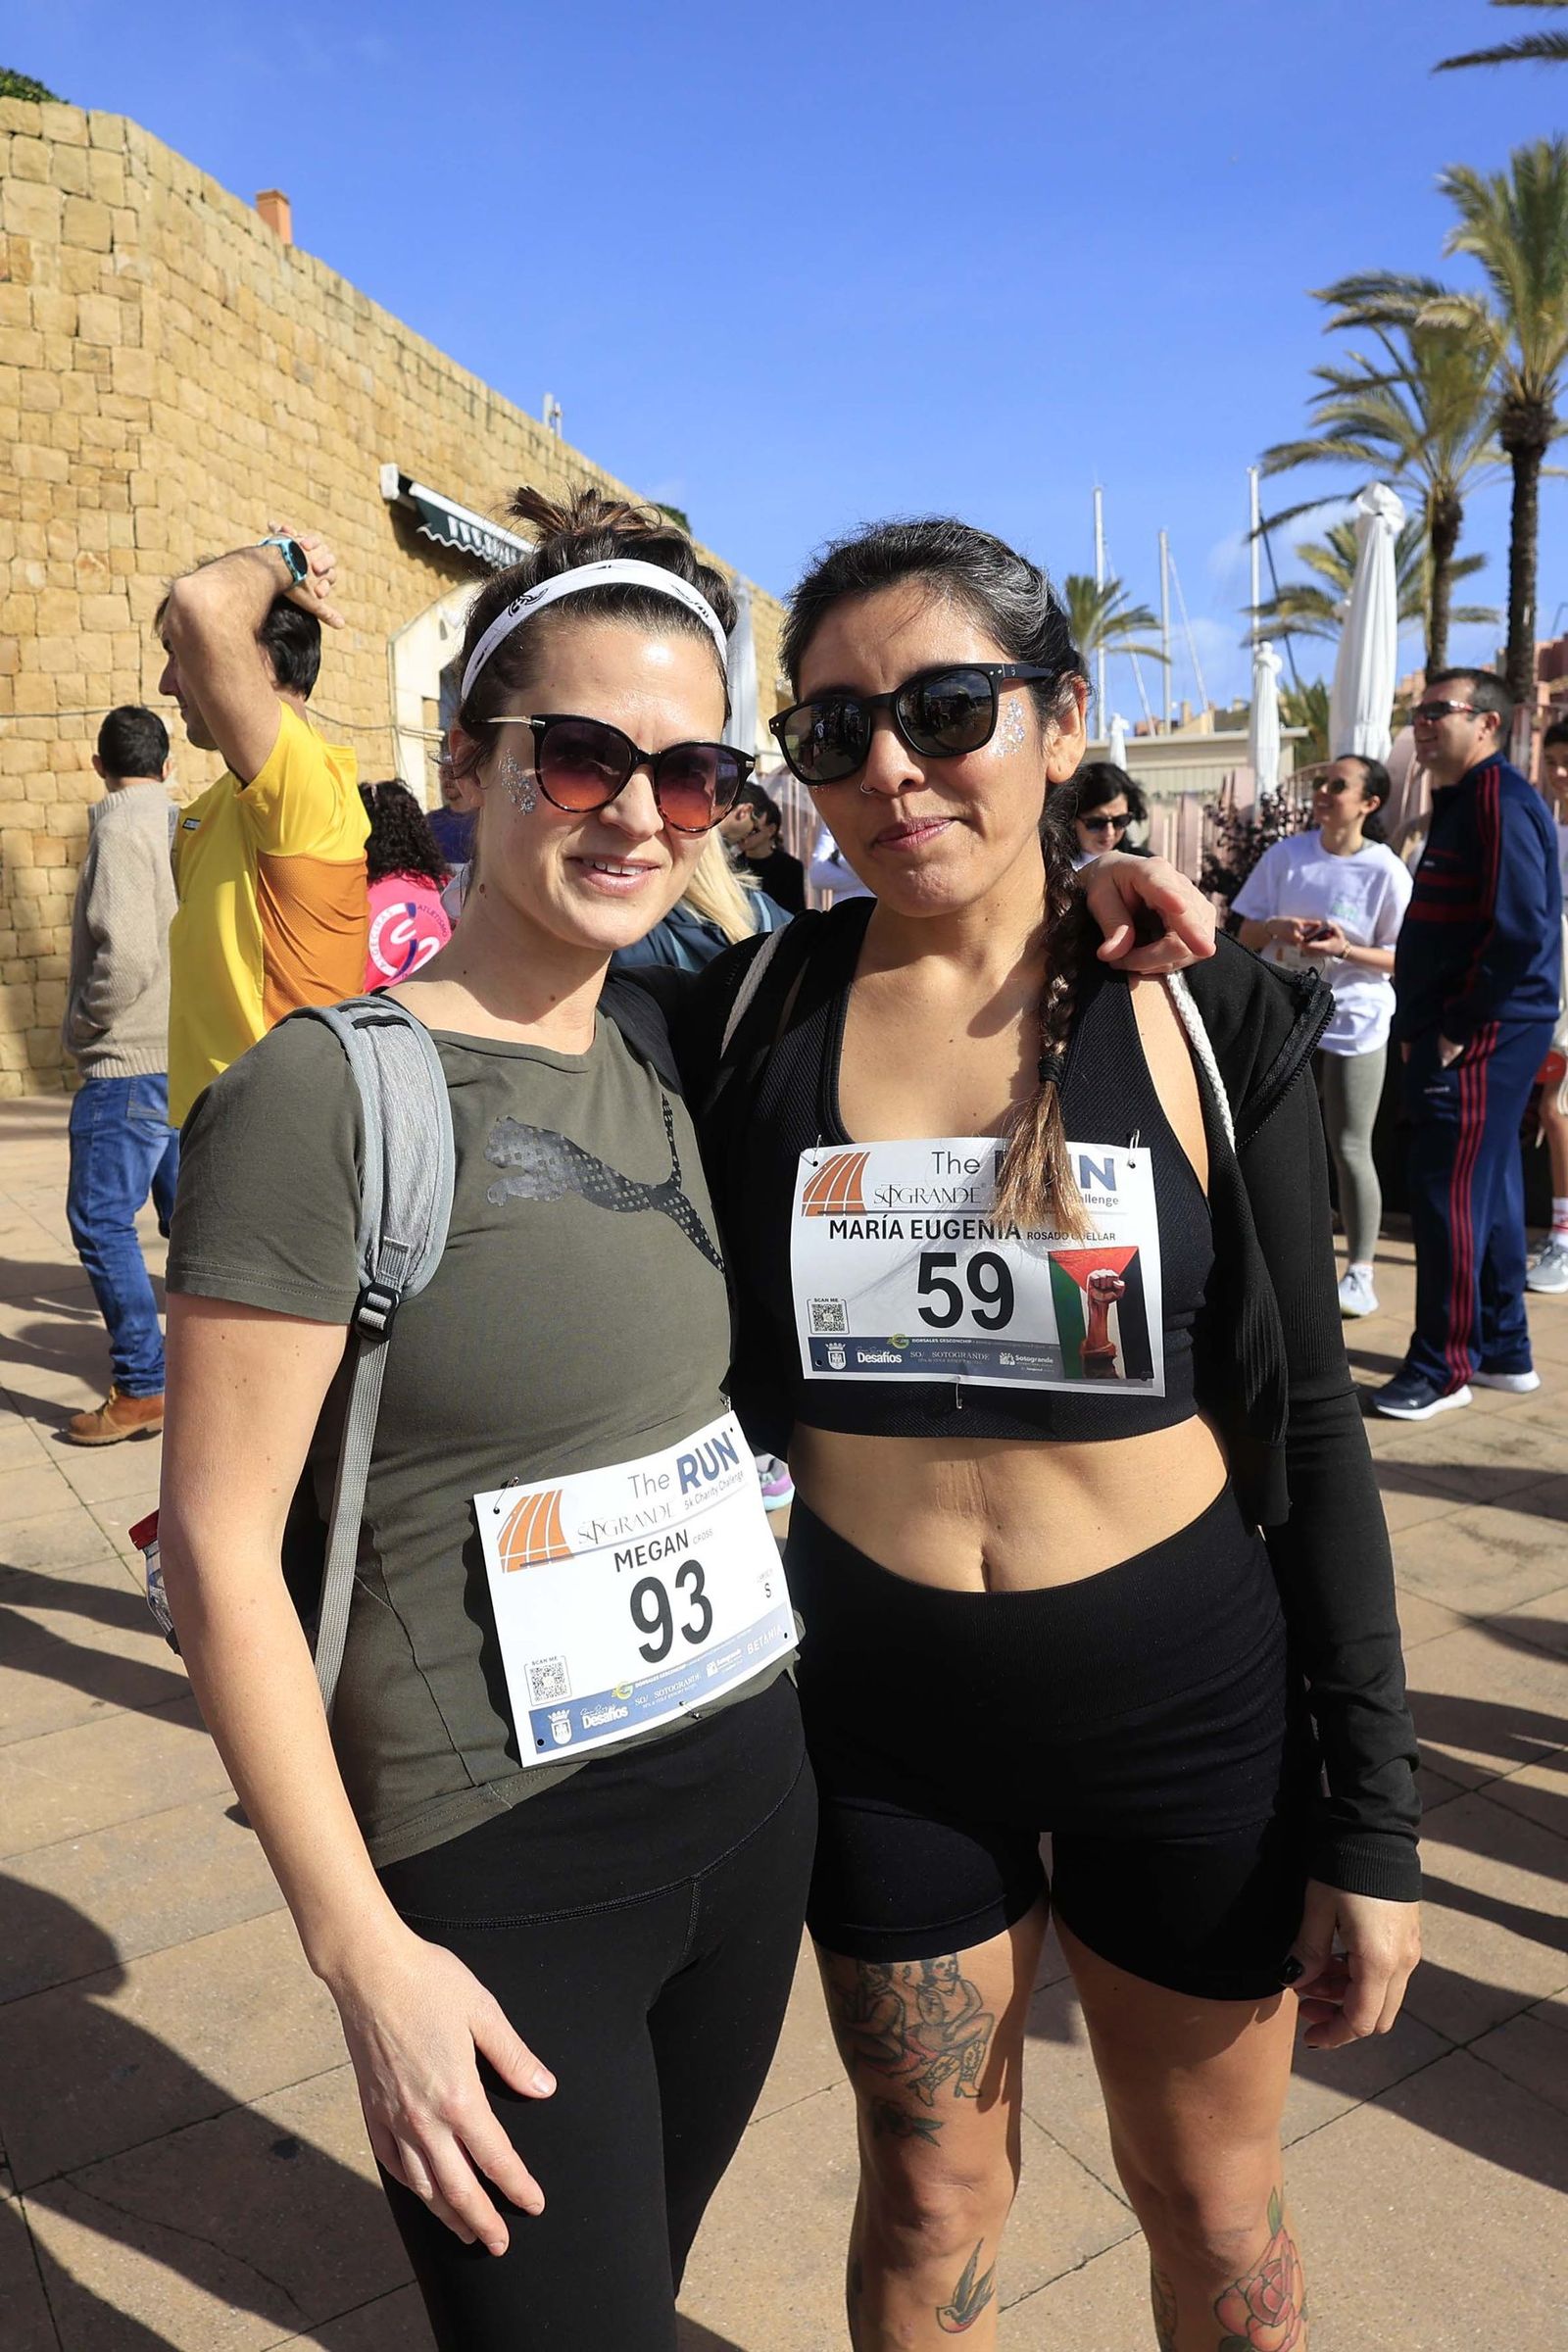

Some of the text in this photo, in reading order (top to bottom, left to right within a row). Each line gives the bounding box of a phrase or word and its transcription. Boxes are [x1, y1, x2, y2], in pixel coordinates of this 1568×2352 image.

[931, 1151, 980, 1175] The
[1073, 1193, 1119, 1207] llenge
[830, 1213, 905, 1240] MARÍA
[910, 1219, 1021, 1241] EUGENIA
[1027, 1231, 1069, 1242] ROSADO
[916, 1251, 1015, 1331] 59
[856, 1351, 903, 1364] Desafíos
[1014, 1353, 1054, 1364] Sotogrande
[627, 1431, 741, 1499] The RUN
[613, 1529, 689, 1573] MEGAN
[763, 1582, 772, 1598] S
[629, 1559, 713, 1664] 93
